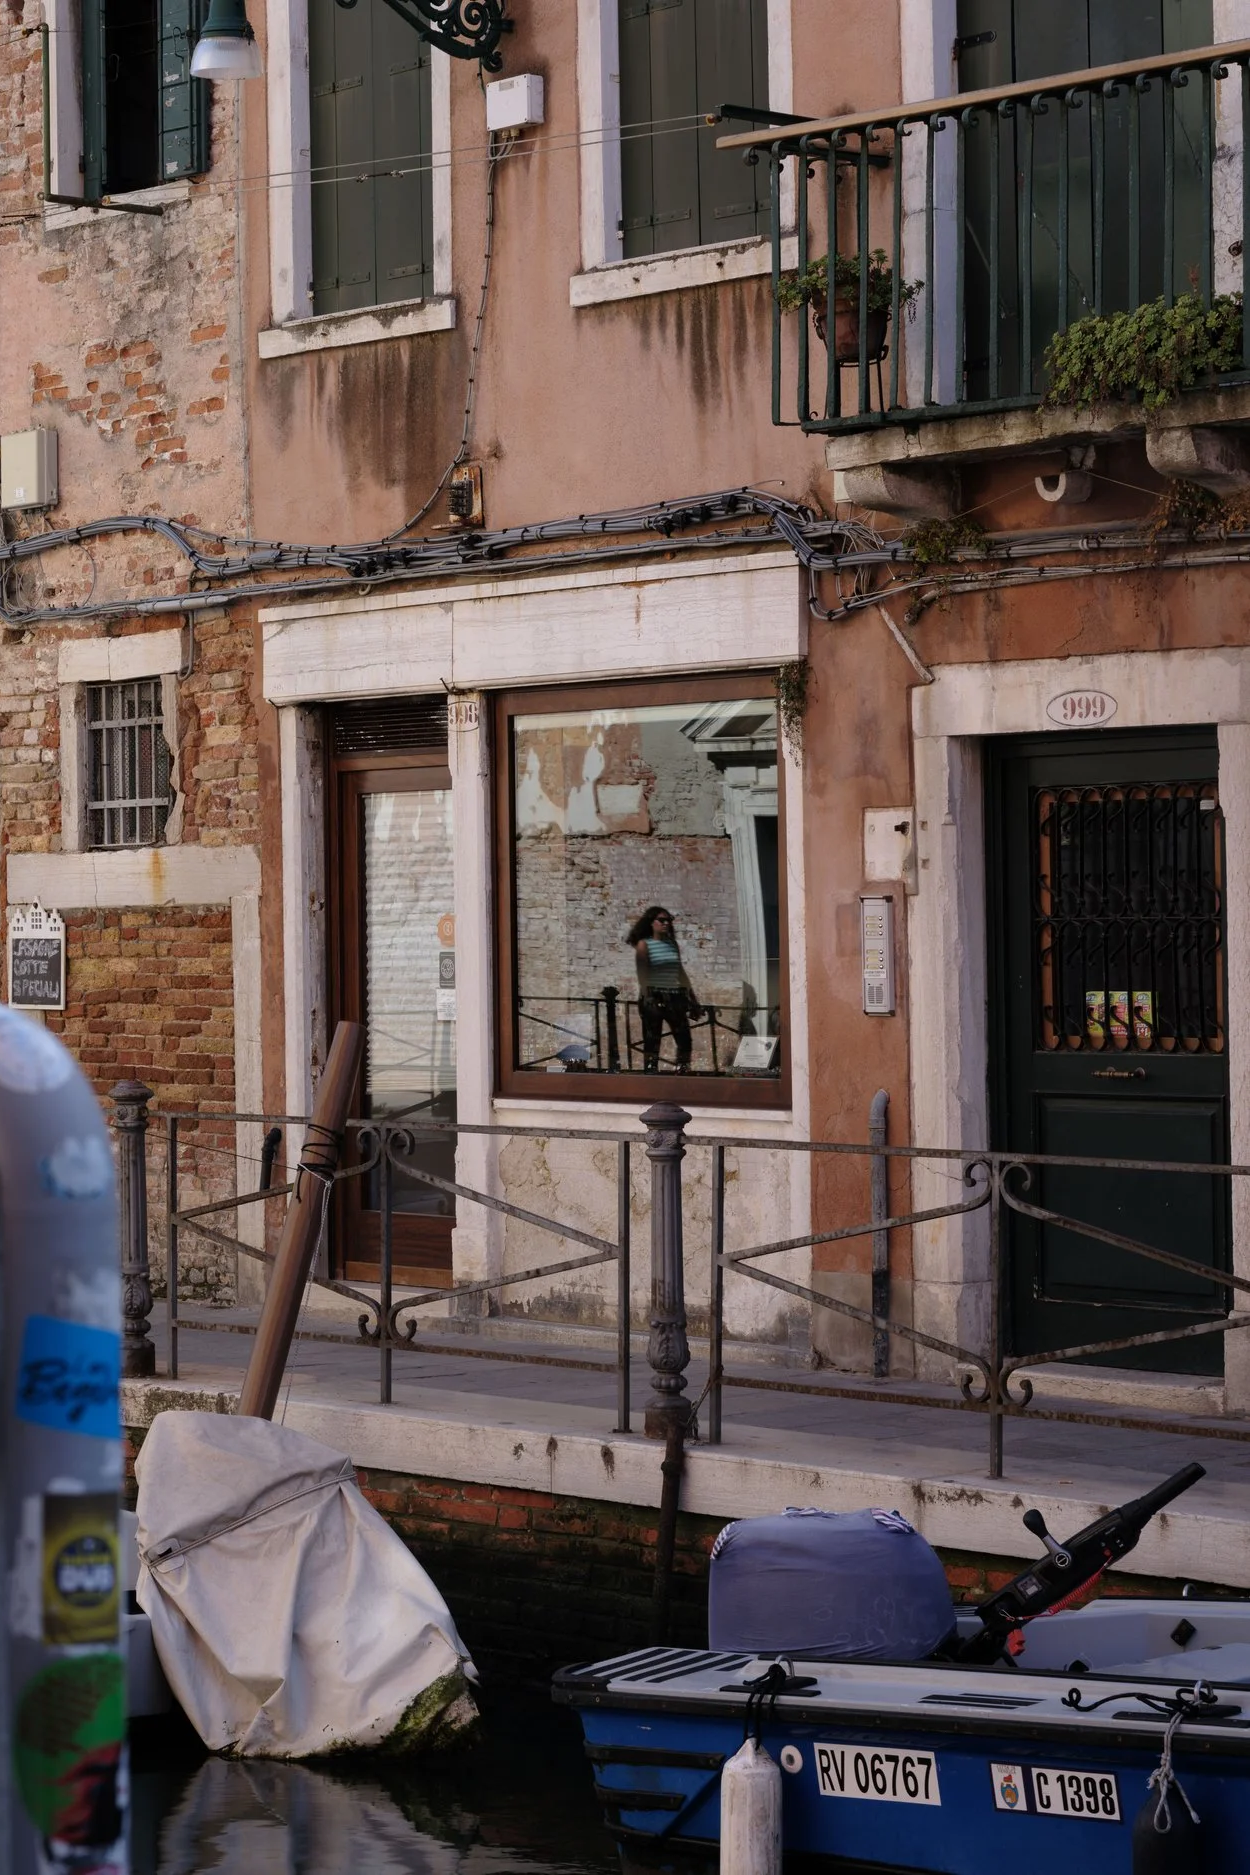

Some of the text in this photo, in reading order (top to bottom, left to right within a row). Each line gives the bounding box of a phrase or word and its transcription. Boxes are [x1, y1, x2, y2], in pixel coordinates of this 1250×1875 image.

[449, 704, 478, 724] 998
[1062, 696, 1106, 720] 999
[817, 1748, 933, 1800] RV 06767
[1036, 1772, 1116, 1816] C 1398
